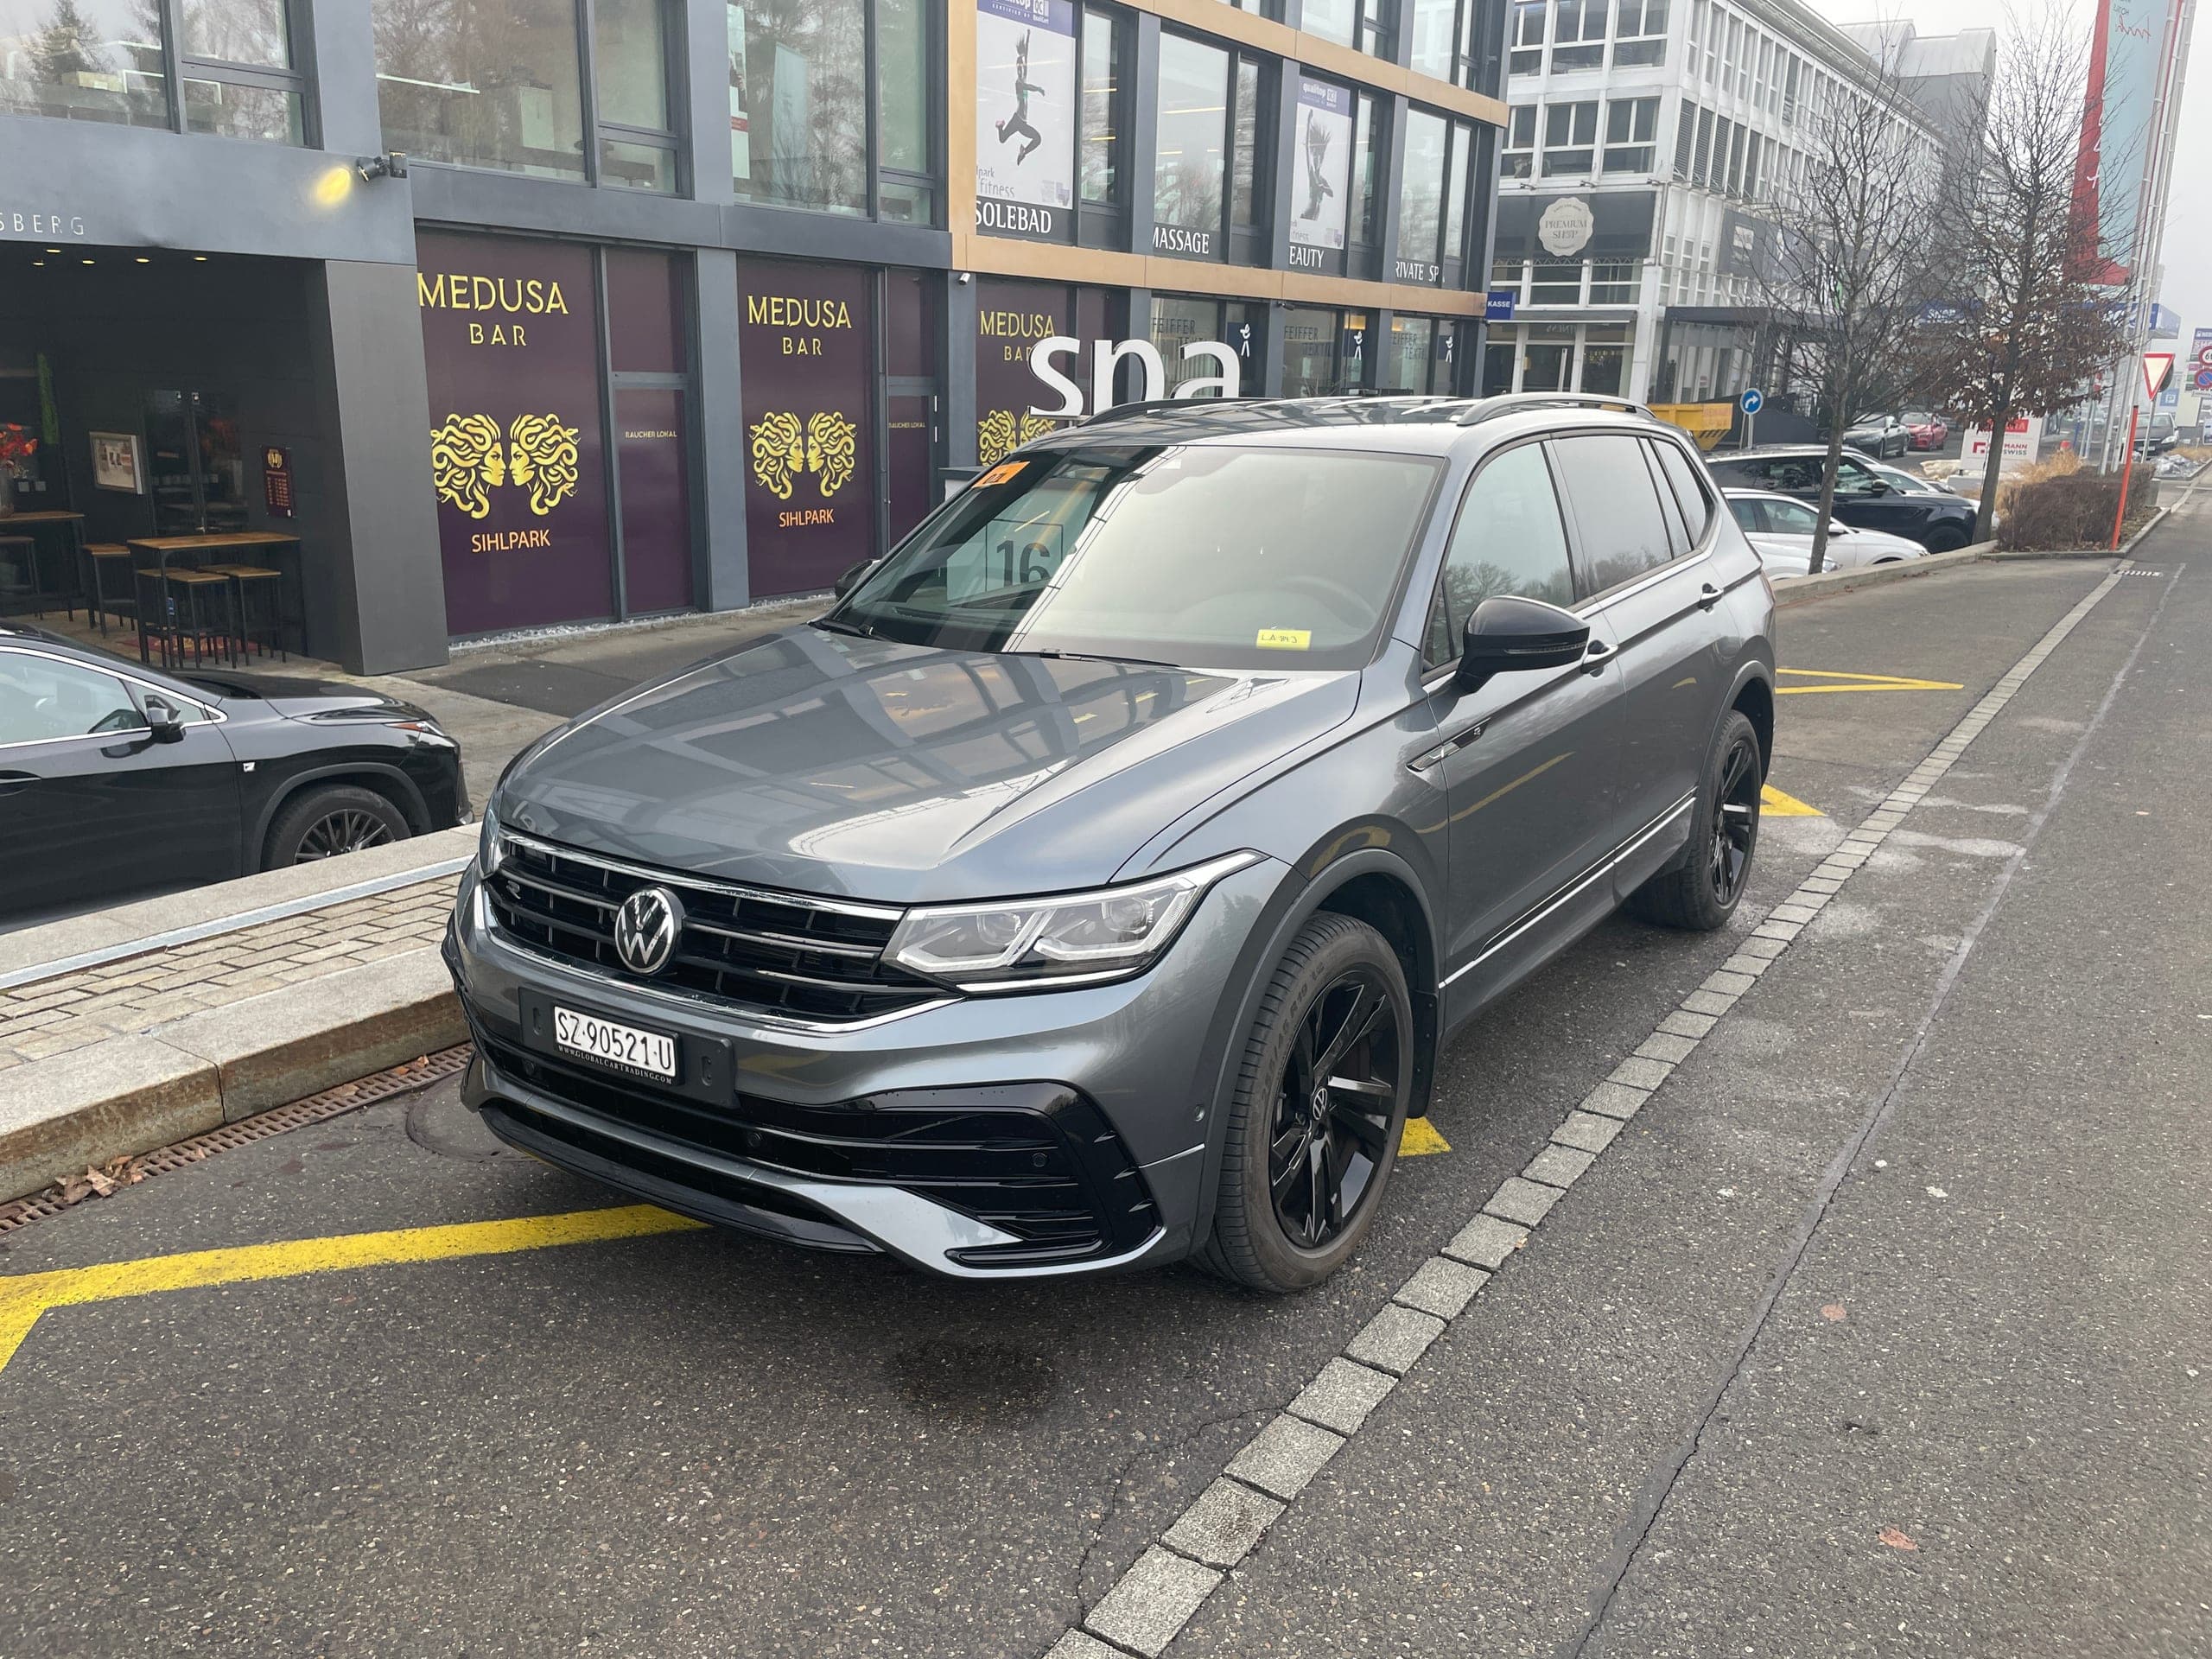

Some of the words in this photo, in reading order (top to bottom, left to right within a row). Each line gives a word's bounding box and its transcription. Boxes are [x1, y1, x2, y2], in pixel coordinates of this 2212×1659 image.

[1289, 245, 1325, 269] EAUTY
[1395, 261, 1425, 281] RIVATE
[1428, 264, 1446, 283] SP
[416, 272, 569, 315] MEDUSA
[747, 295, 852, 329] MEDUSA
[469, 323, 527, 346] BAR
[980, 310, 1055, 338] MEDUSA
[1152, 317, 1196, 334] FEIFFER
[1284, 325, 1319, 340] FEIFFER
[782, 336, 823, 356] BAR
[778, 508, 835, 528] SIHLPARK
[471, 529, 551, 553] SIHLPARK
